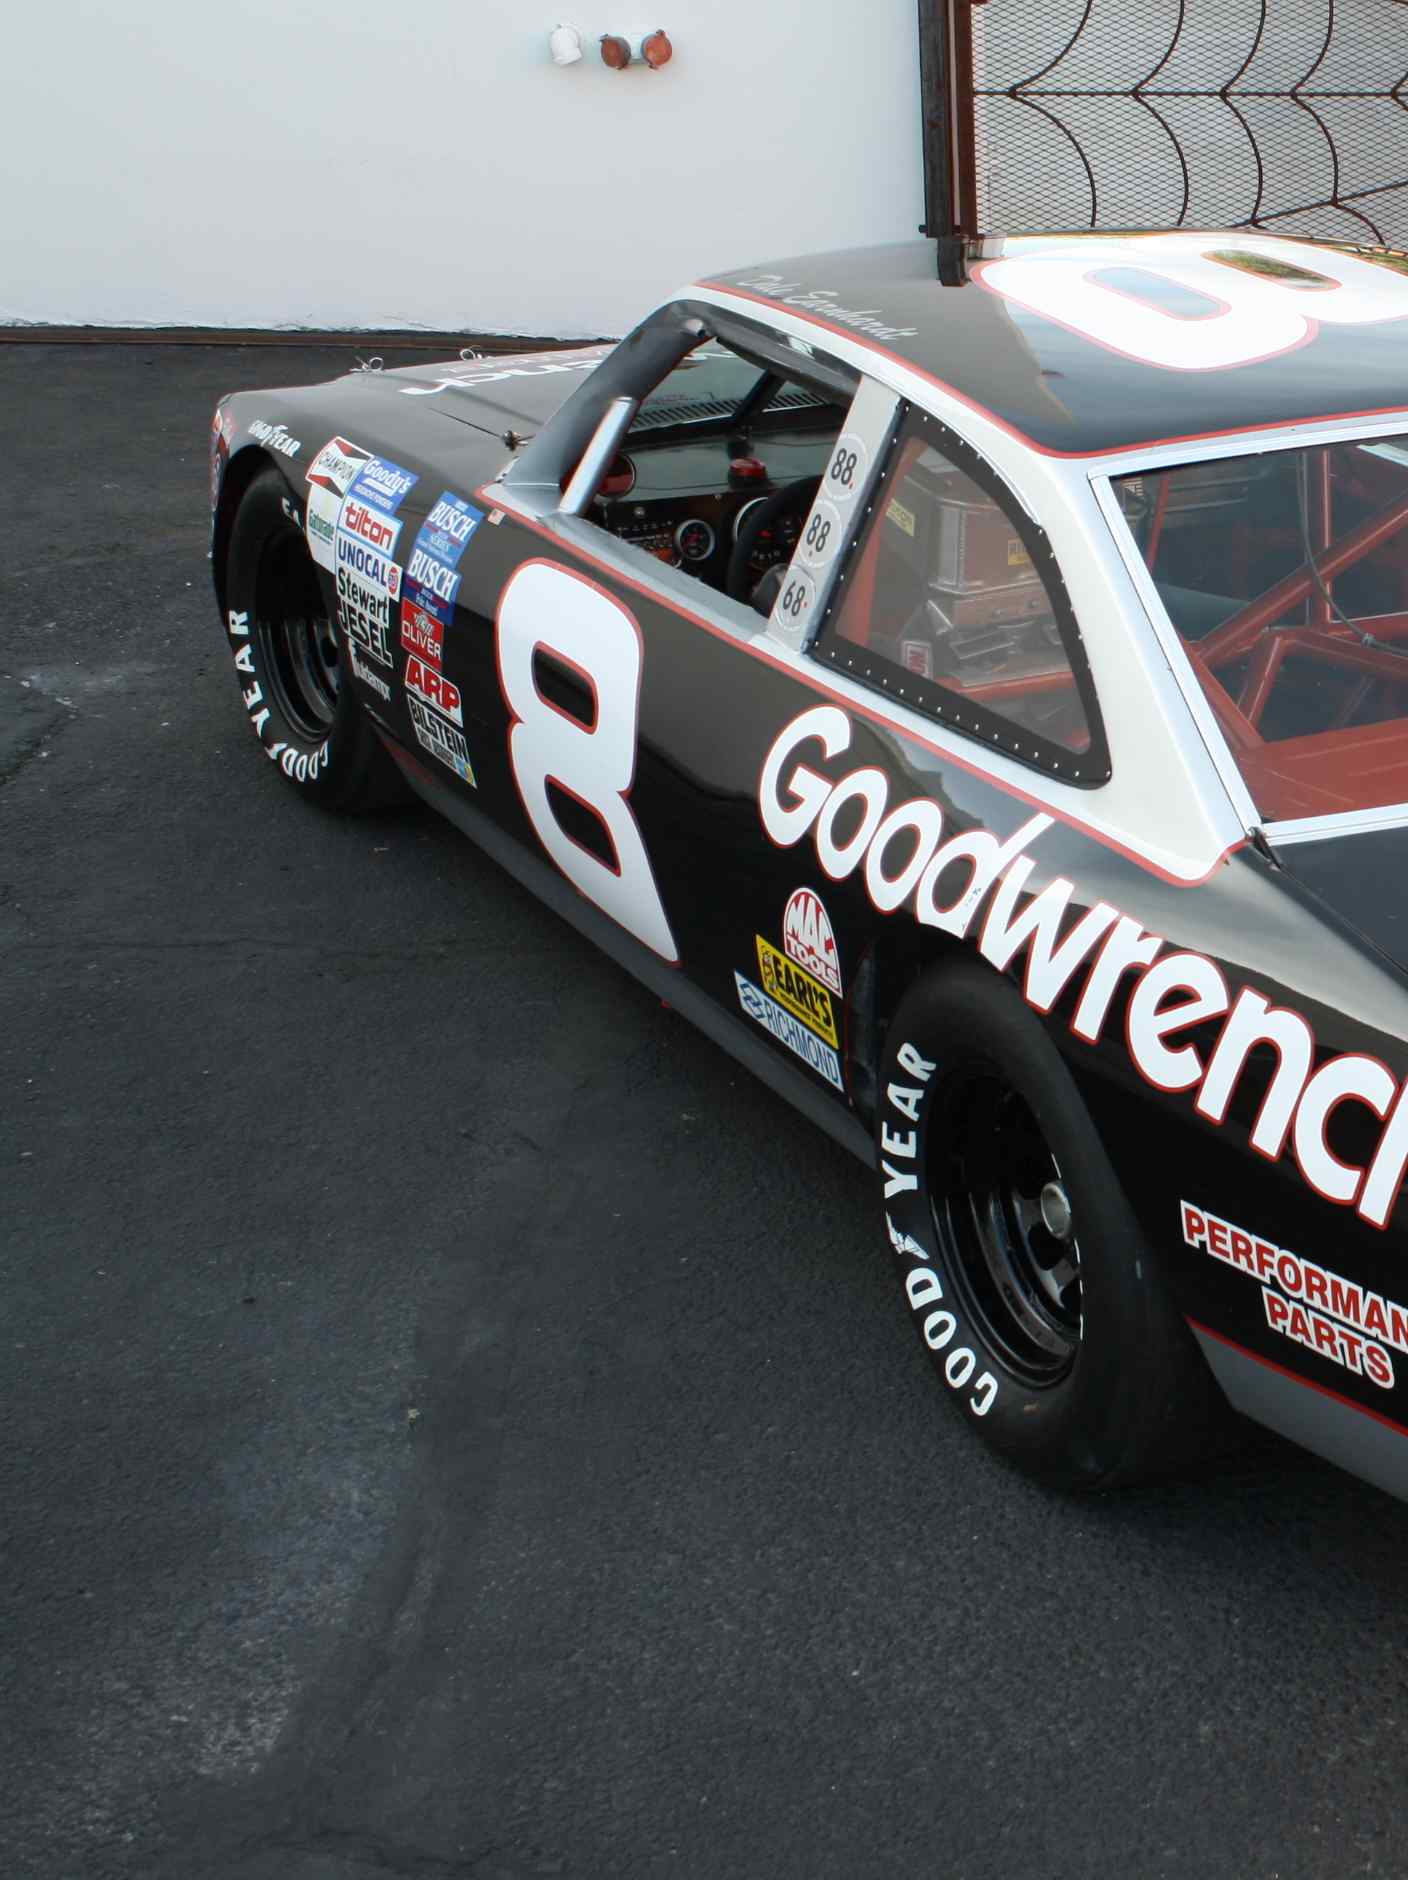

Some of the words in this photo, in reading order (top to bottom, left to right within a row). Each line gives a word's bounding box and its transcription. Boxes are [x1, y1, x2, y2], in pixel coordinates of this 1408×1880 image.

[363, 459, 412, 496] Goody's
[345, 502, 393, 551] tilton
[428, 501, 477, 541] BUSCH
[338, 538, 387, 587] UNOCAL
[407, 548, 459, 602] BUSCH
[338, 566, 390, 624] Stewart
[338, 600, 393, 668] JESEL
[401, 620, 442, 661] OLIVER
[405, 657, 461, 713] ARP
[496, 557, 683, 970] 8
[785, 893, 838, 969] MAC
[786, 936, 841, 990] TOOLS
[764, 1001, 839, 1084] RICHMOND
[1261, 1285, 1395, 1389] PARTS
